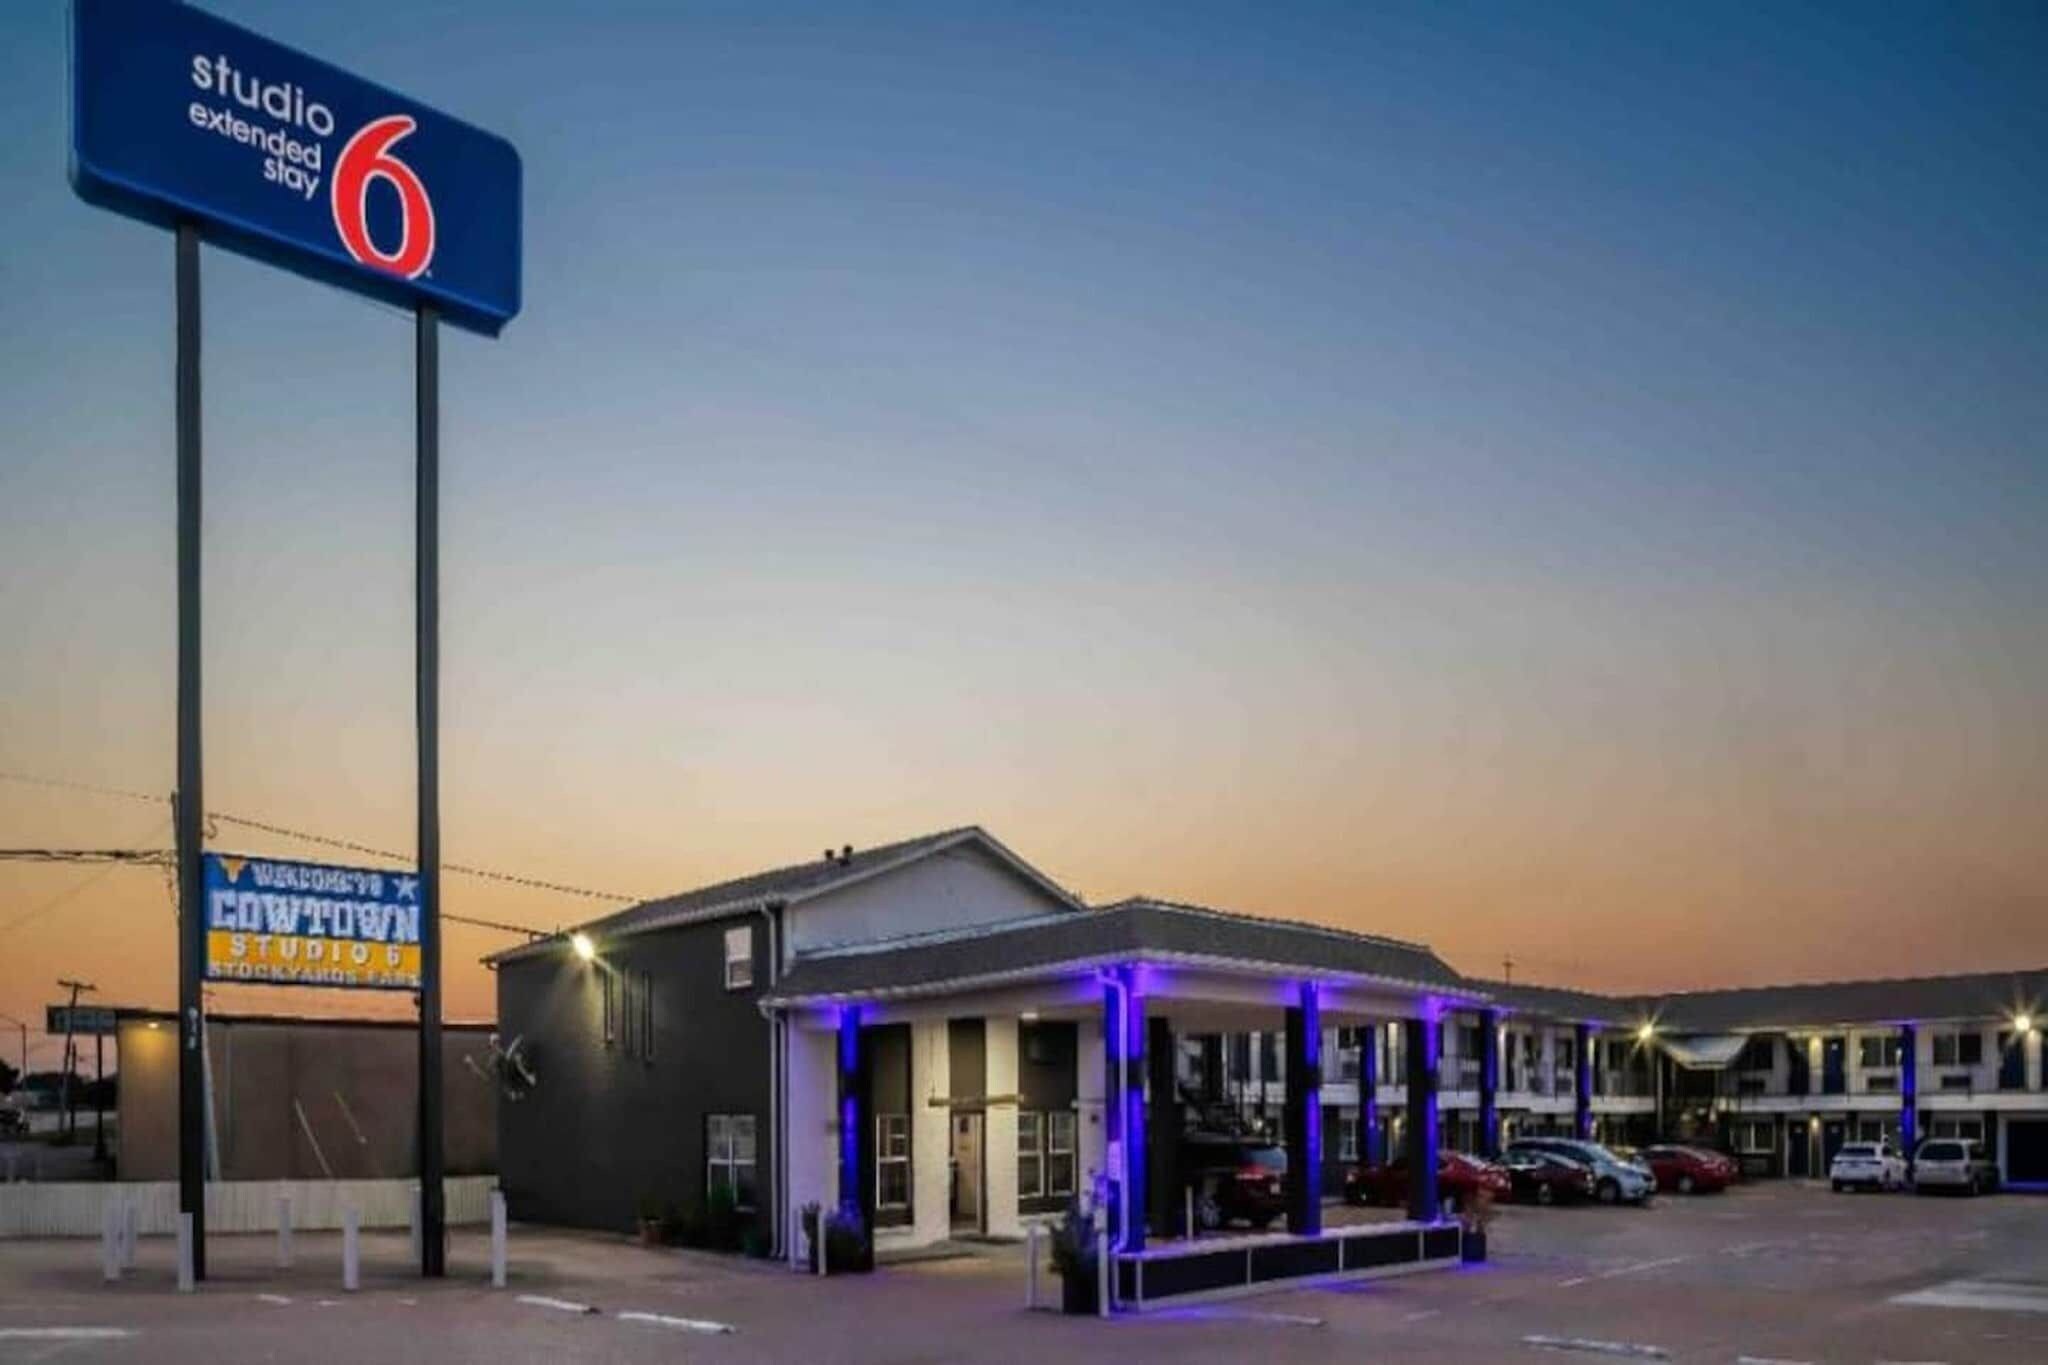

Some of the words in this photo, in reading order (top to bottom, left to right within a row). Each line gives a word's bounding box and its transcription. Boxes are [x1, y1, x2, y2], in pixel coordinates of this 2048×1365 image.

[191, 54, 334, 136] studio
[189, 102, 322, 173] extended
[263, 158, 319, 200] stay
[330, 114, 435, 280] 6
[211, 890, 419, 942] COWTOWN
[231, 934, 370, 963] STUDIO
[387, 945, 400, 966] 6
